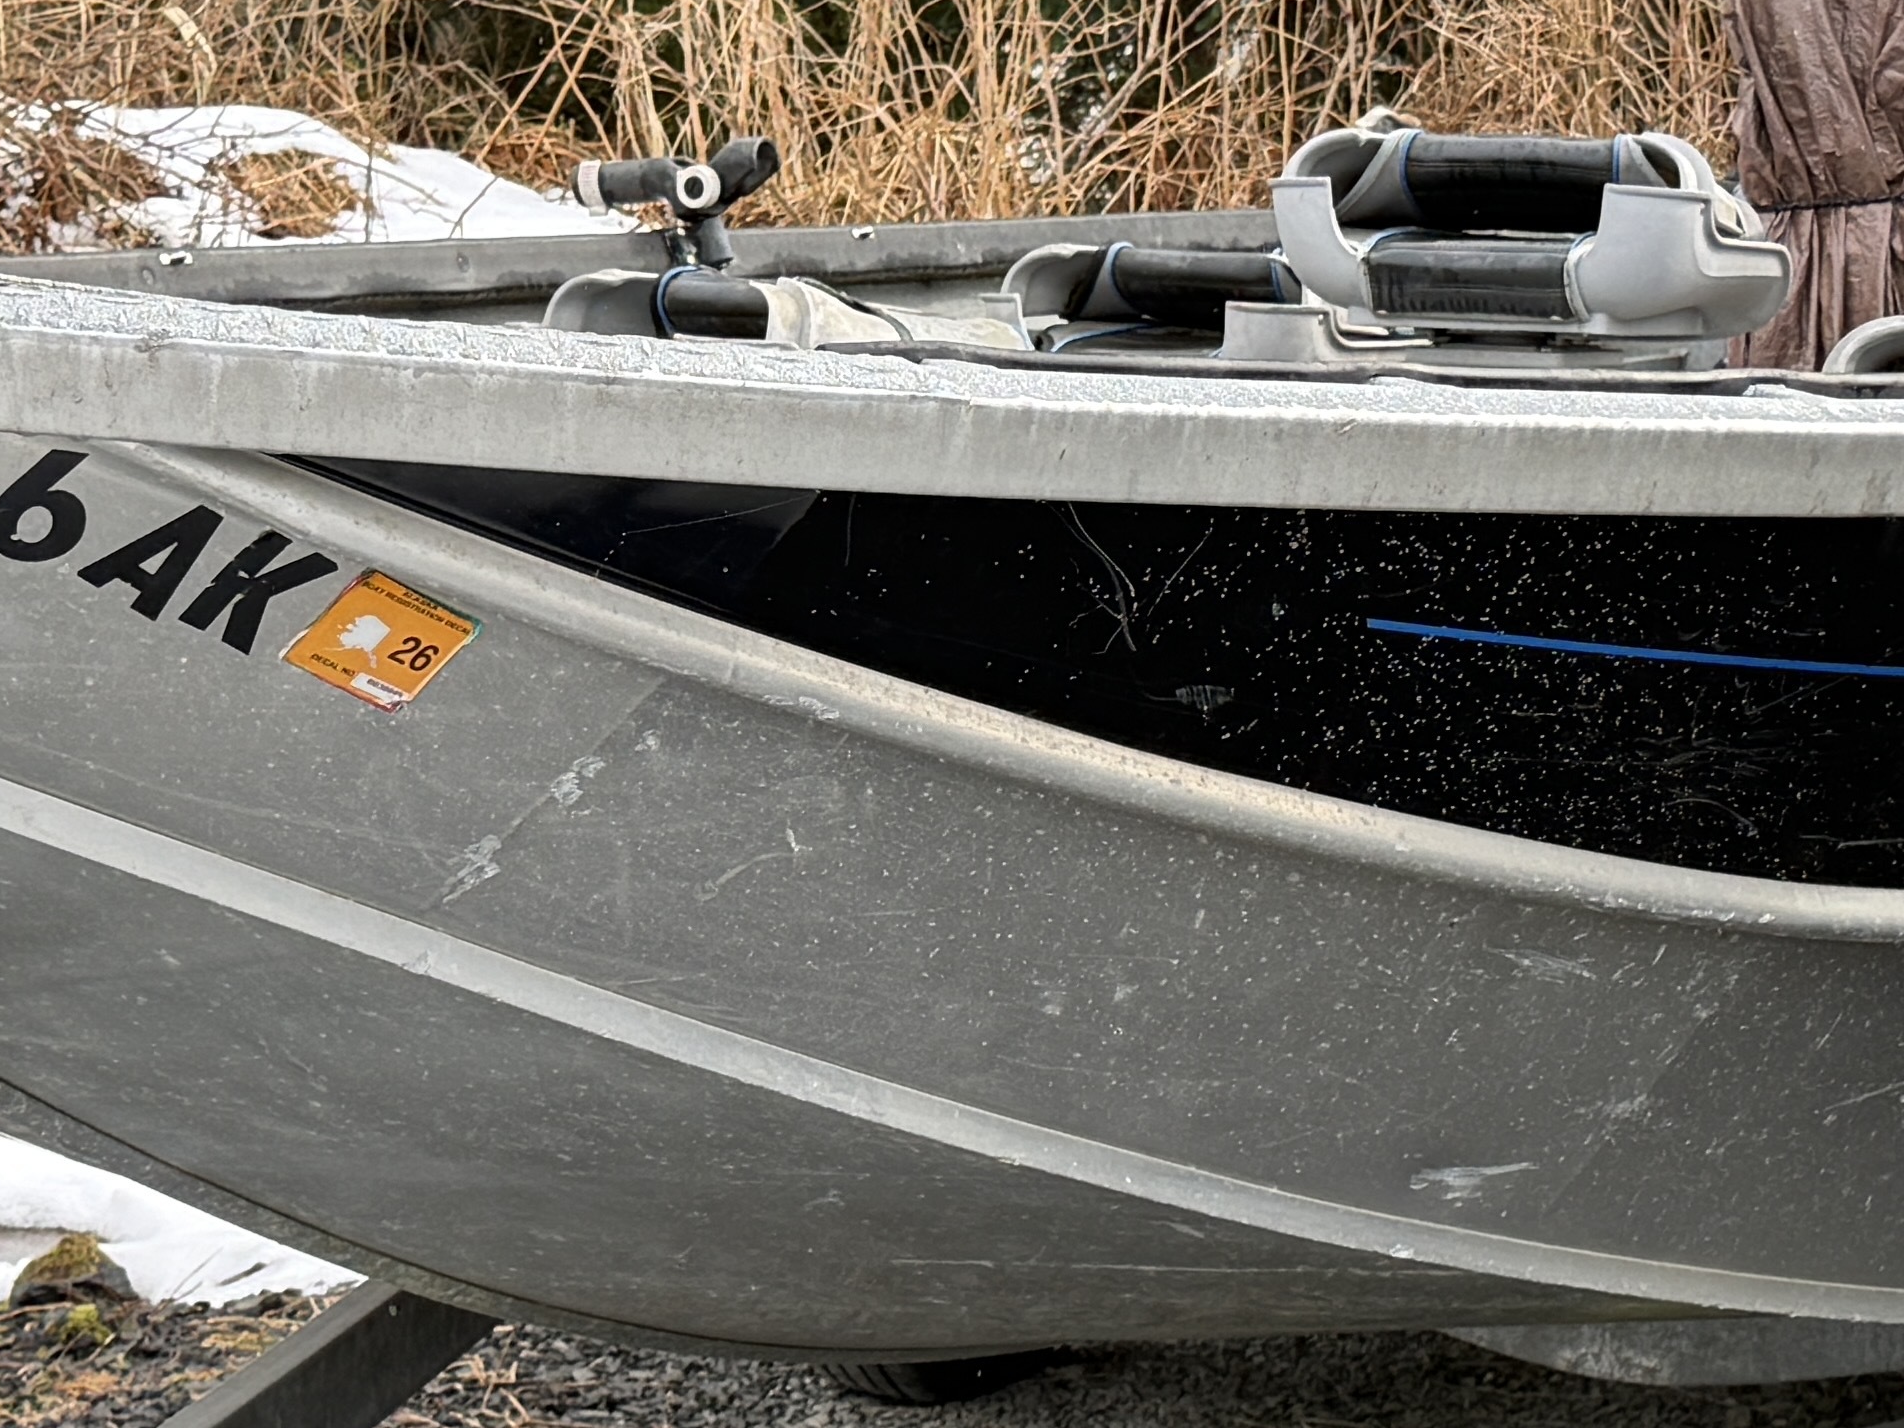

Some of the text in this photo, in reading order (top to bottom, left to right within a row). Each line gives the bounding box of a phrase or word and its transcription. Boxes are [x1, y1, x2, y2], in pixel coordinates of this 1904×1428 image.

[77, 504, 339, 655] AK
[309, 652, 340, 671] DECAL
[387, 635, 440, 672] 26
